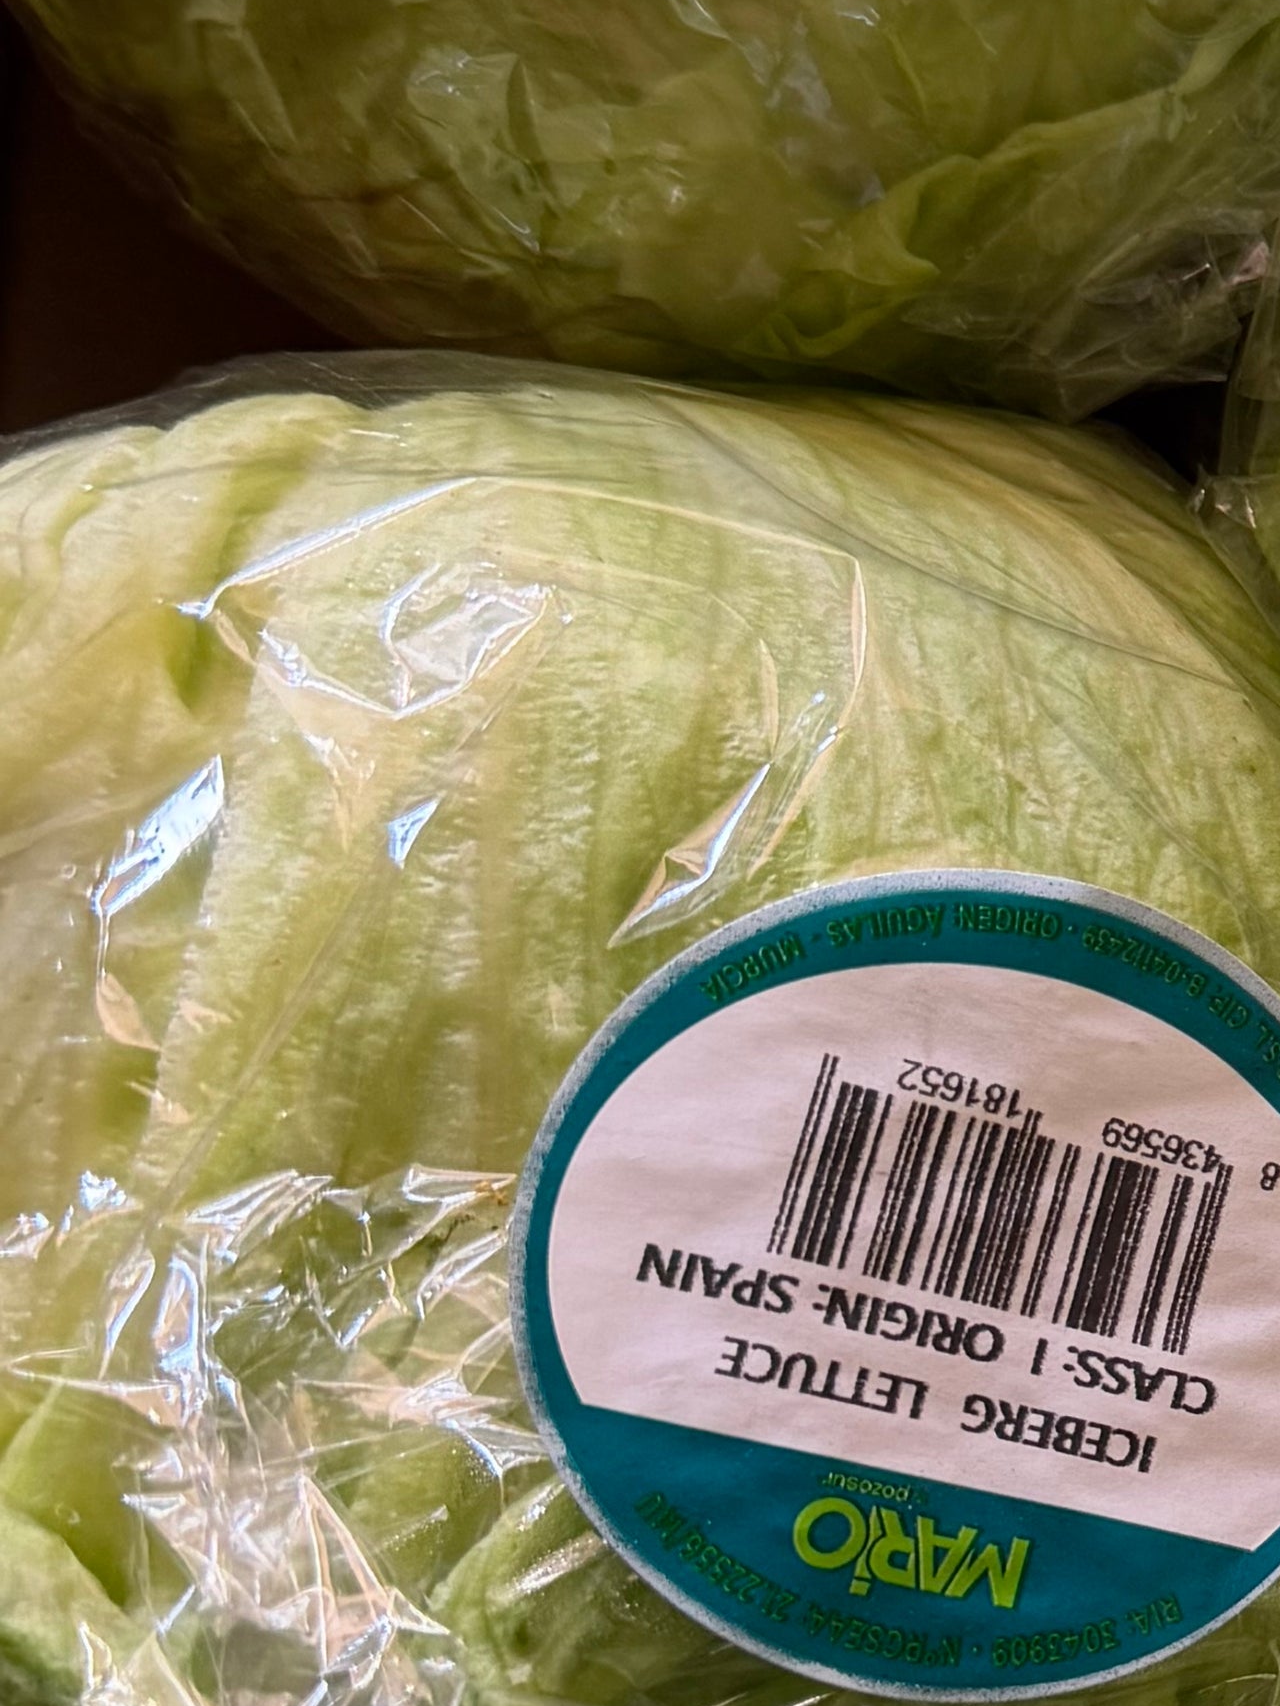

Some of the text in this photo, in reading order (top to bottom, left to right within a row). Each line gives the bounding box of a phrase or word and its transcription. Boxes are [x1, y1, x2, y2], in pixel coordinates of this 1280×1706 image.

[897, 1059, 1280, 1190] 8 436569 181652
[636, 1243, 1216, 1414] CLASS: I ORIGIN: SPAIN
[714, 1336, 1156, 1472] ICEBERG LETTUCE
[820, 1470, 909, 1501] pozosur
[992, 1619, 1118, 1666] 3043909
